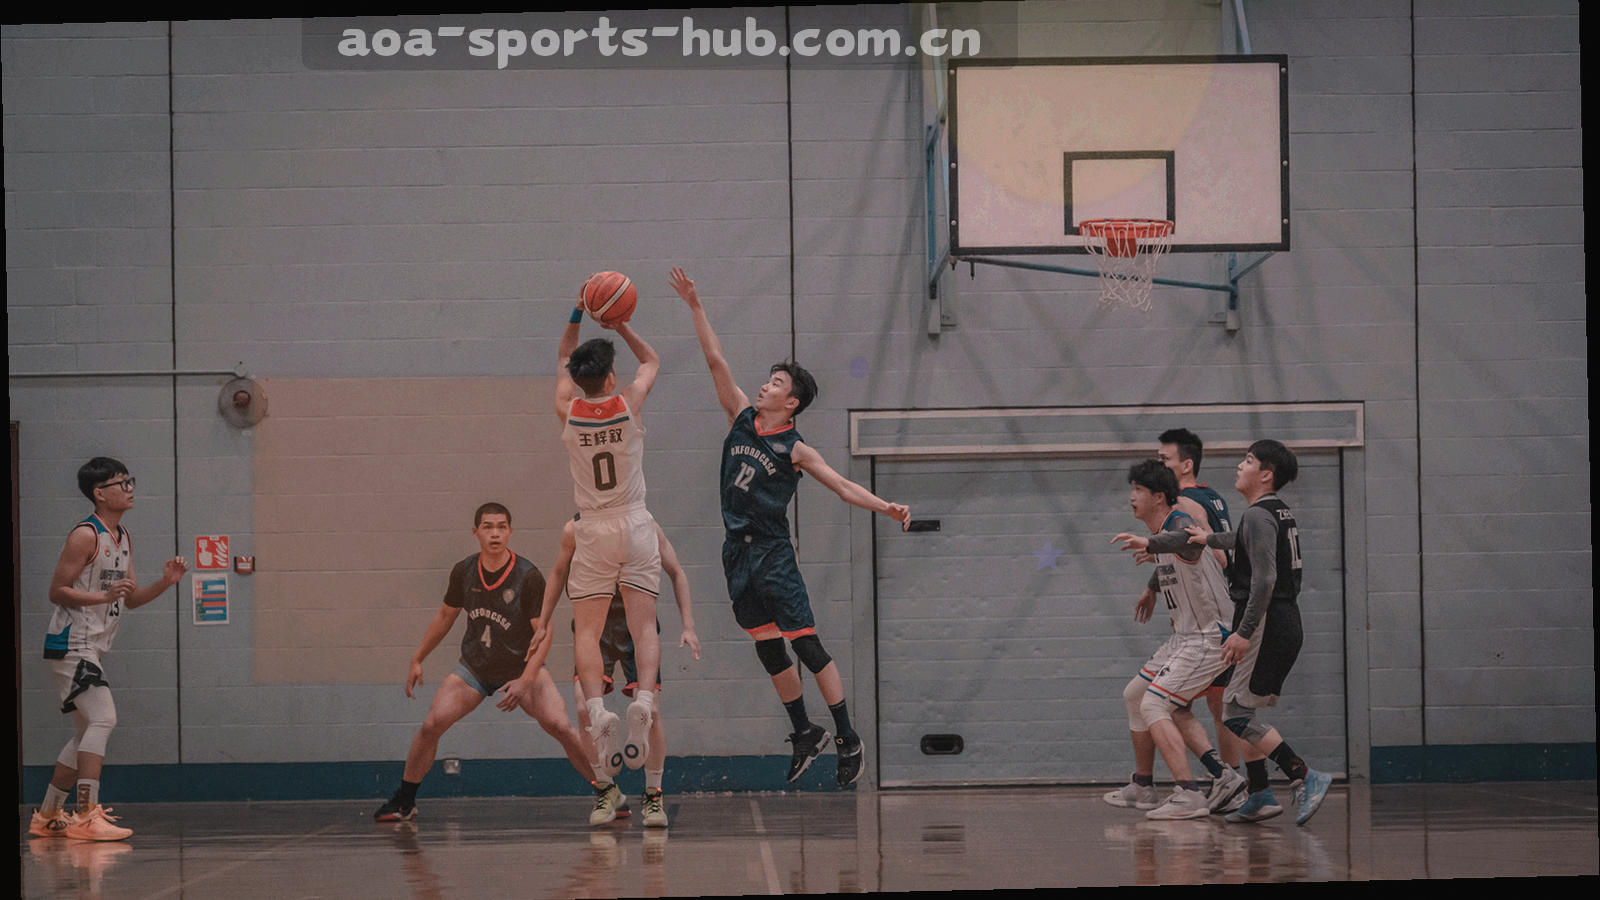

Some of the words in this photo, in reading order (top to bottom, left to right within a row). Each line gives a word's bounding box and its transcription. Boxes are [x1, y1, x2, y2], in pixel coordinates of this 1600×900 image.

[592, 451, 617, 491] 0
[734, 461, 756, 492] 12
[480, 624, 492, 649] 4
